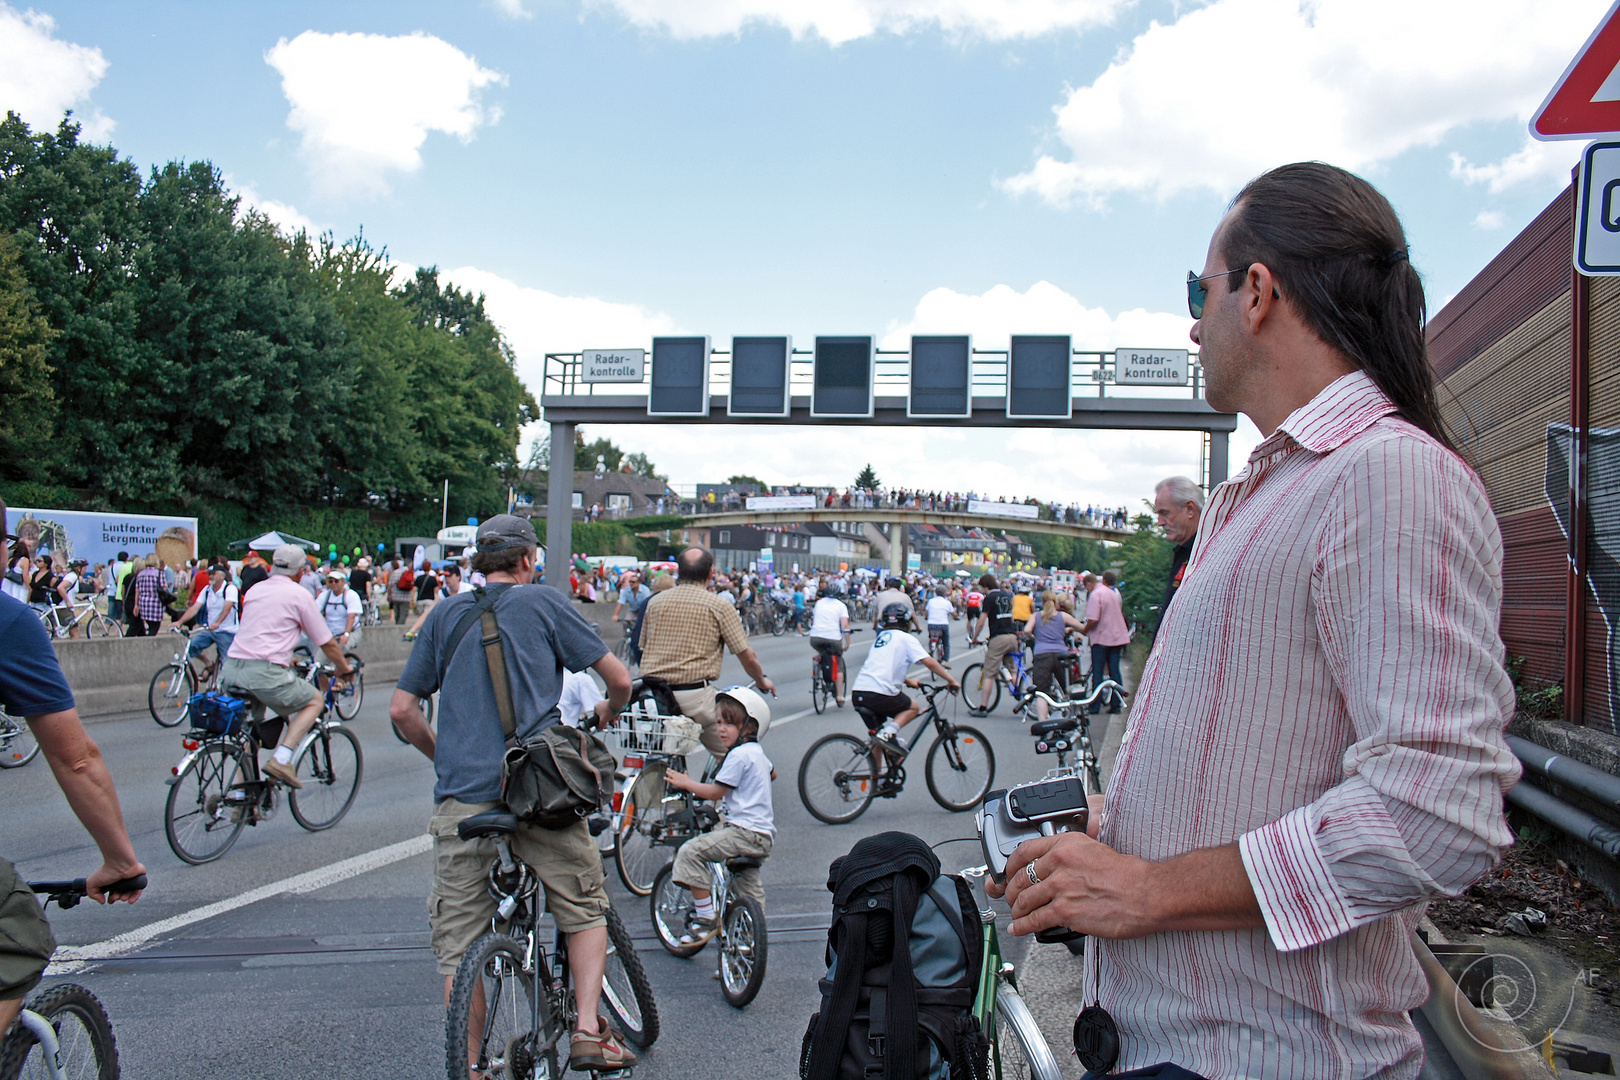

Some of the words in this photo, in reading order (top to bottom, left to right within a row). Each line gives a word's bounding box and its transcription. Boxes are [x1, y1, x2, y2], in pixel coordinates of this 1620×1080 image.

[595, 354, 630, 365] Radar-
[1131, 354, 1172, 364] Radar-
[590, 366, 635, 376] kontrolle
[1125, 367, 1179, 377] kontrolle
[102, 522, 156, 533] Lintforter
[102, 533, 158, 546] Bergmann
